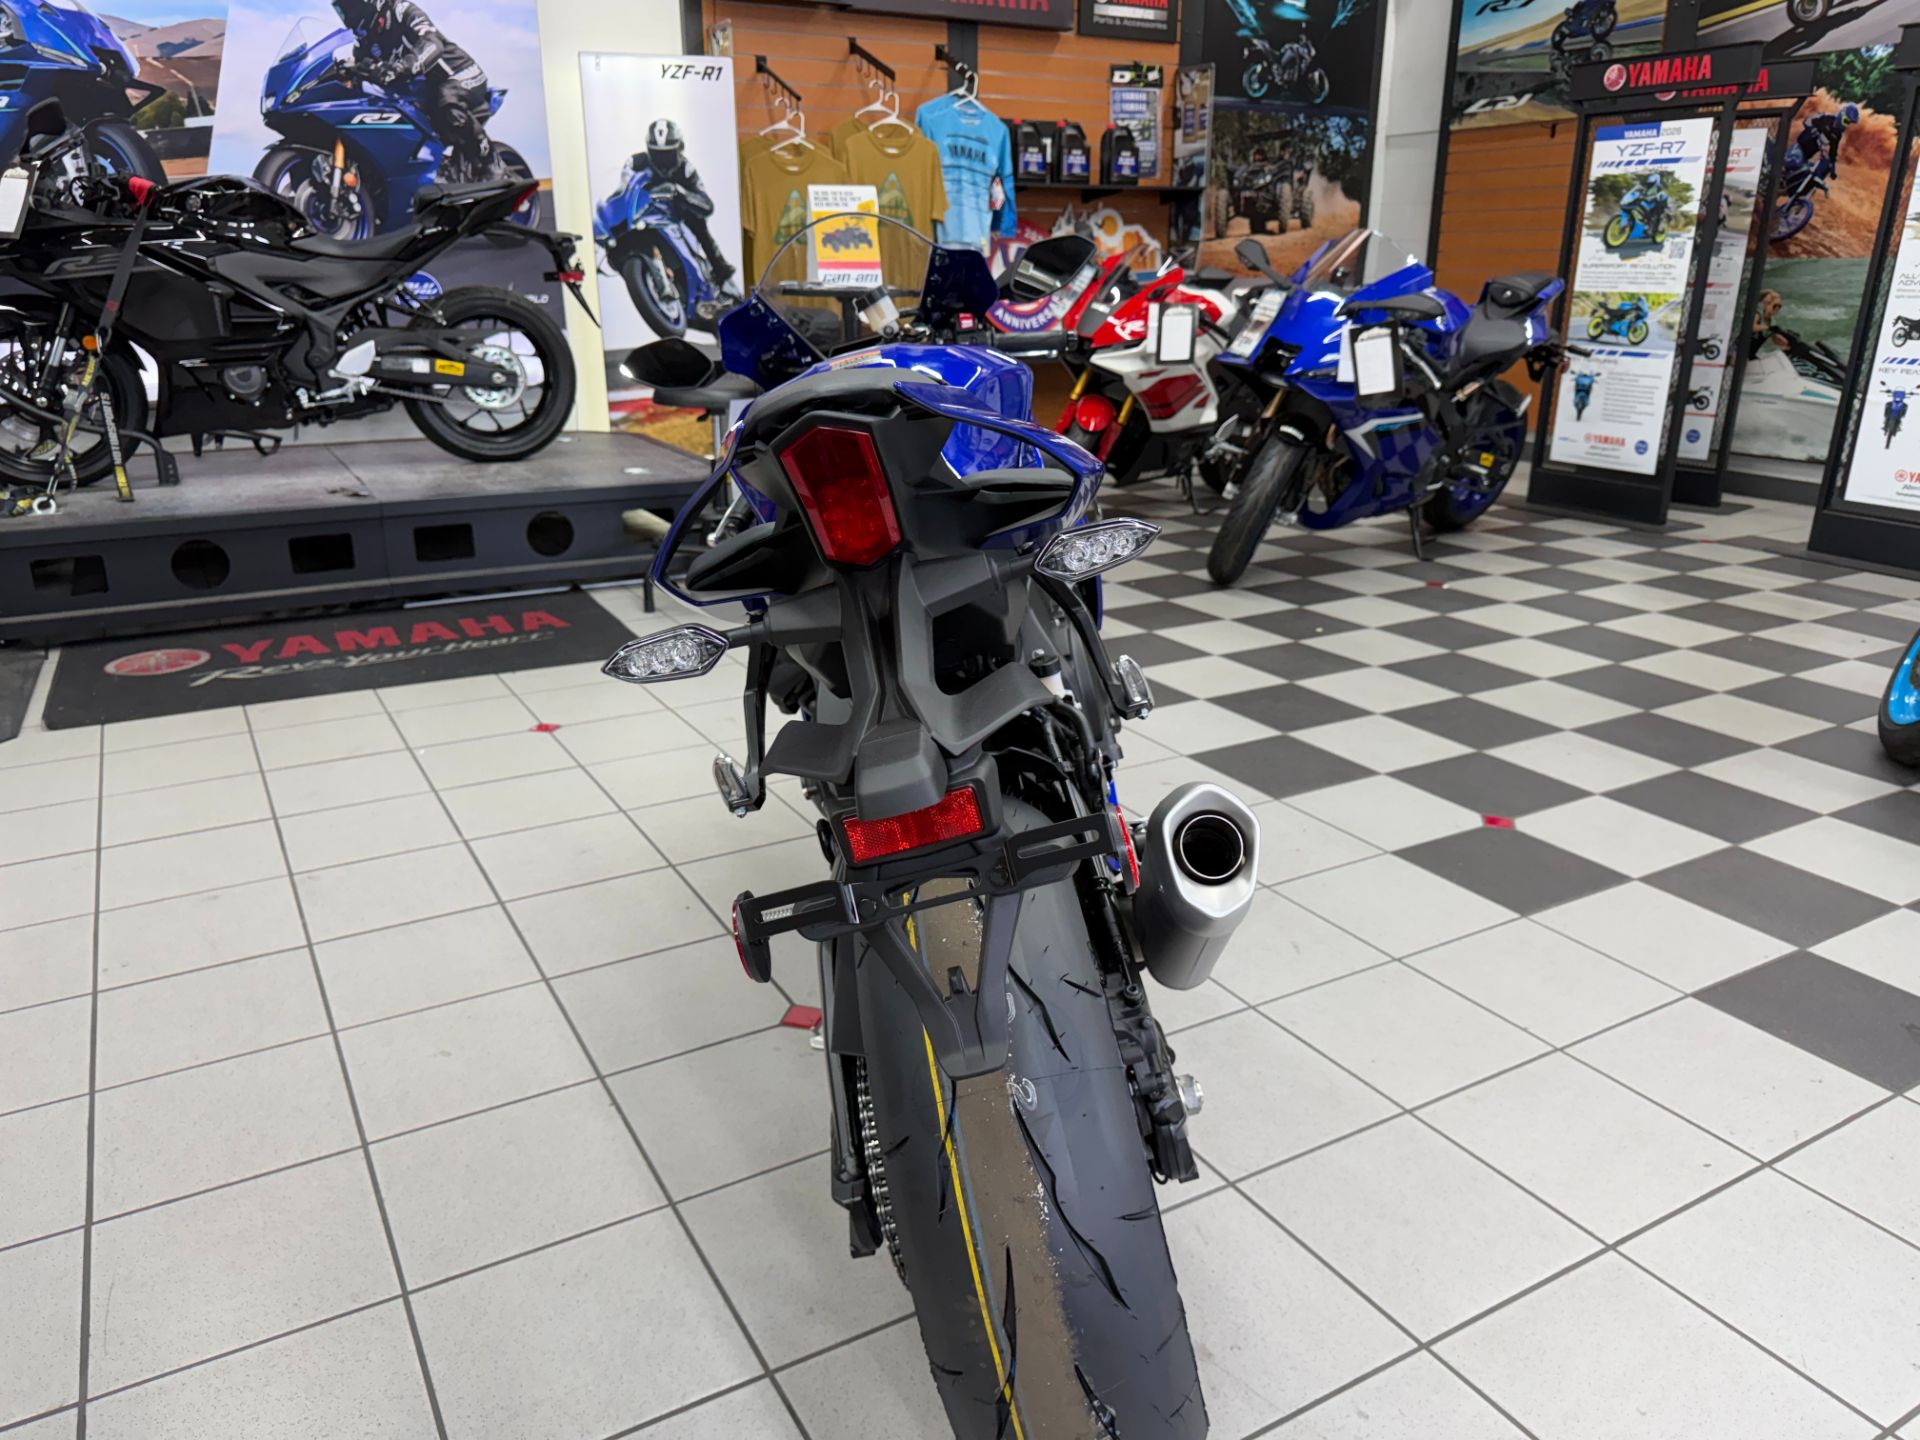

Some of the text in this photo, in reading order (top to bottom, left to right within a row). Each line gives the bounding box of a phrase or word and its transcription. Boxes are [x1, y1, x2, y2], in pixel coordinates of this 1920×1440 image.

[661, 64, 723, 81] YZF-R1
[1628, 54, 1712, 88] YAMAHA
[350, 112, 402, 124] R7
[1624, 129, 1658, 138] YAMAHA
[946, 142, 987, 165] YAMAHA
[1616, 141, 1686, 157] YZF-R7
[222, 609, 572, 665] YAMAHA
[344, 647, 438, 668] Your
